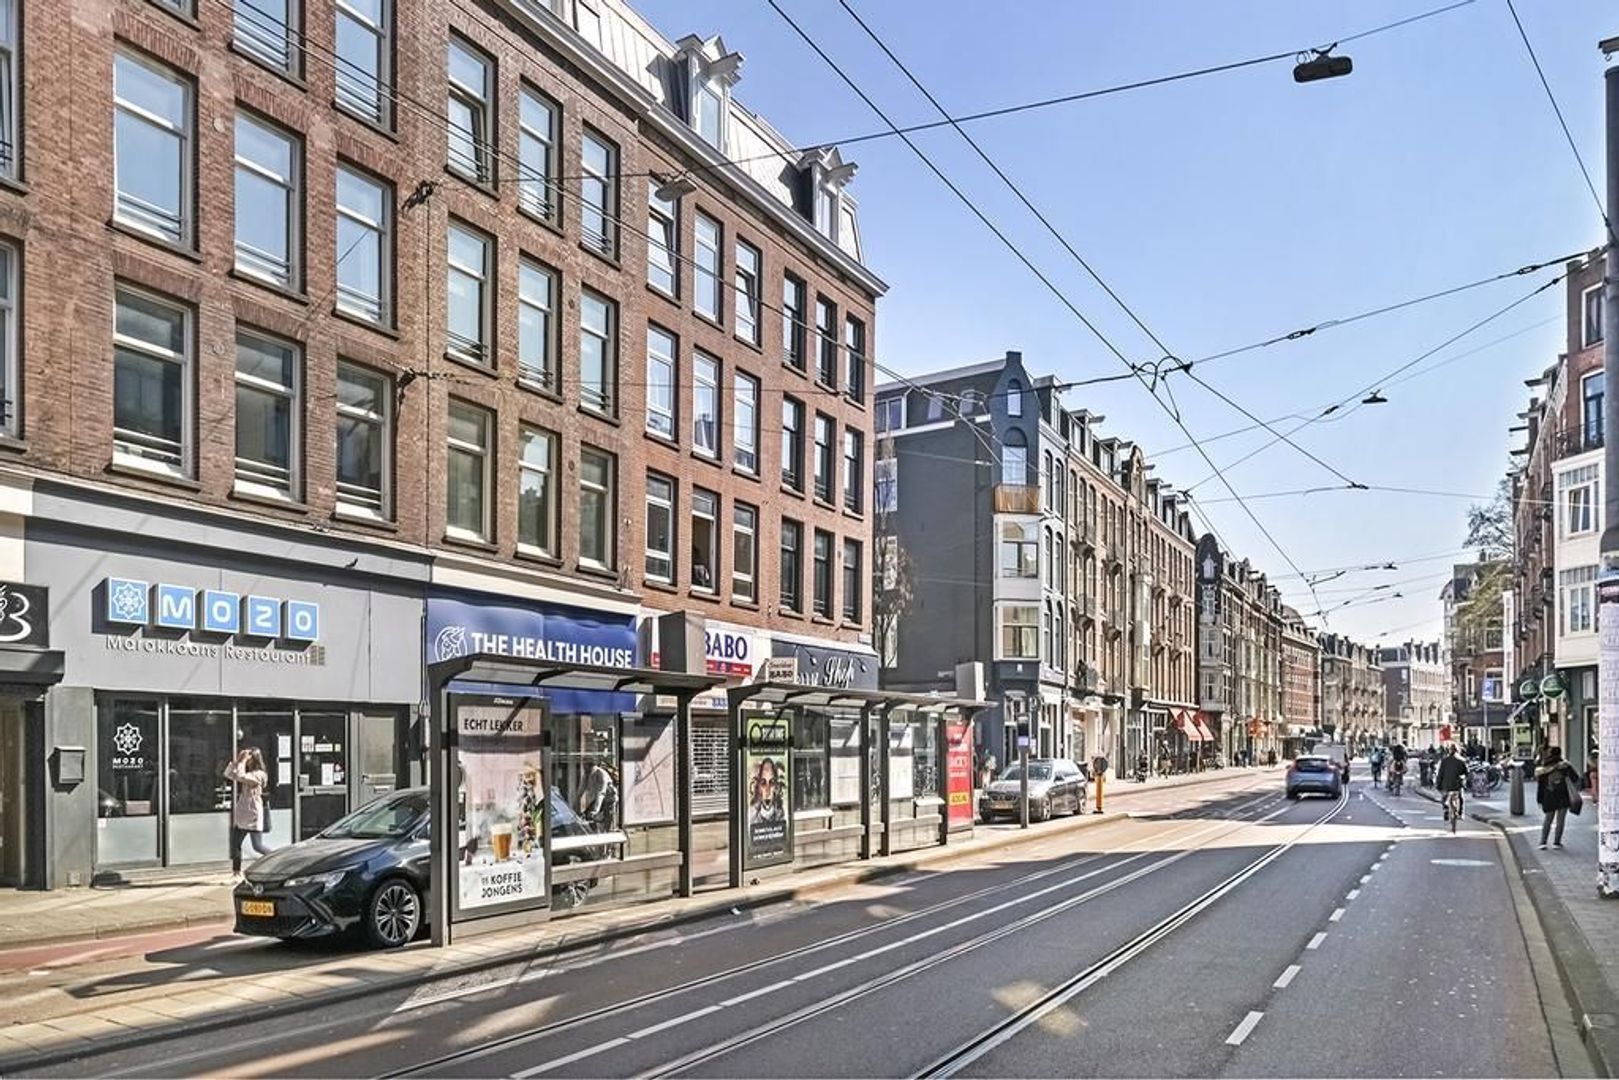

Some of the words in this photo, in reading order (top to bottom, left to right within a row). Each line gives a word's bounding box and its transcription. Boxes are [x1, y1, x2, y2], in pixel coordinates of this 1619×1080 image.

[105, 635, 217, 659] Marokkaans
[224, 645, 311, 666] Restaurant
[471, 633, 508, 654] THE
[513, 637, 577, 664] HEALTH
[580, 646, 632, 668] HOUSE
[463, 718, 487, 730] ECHT
[490, 719, 523, 731] LEKKER
[491, 871, 522, 884] KOFFIE
[481, 884, 523, 898] JONGENS
